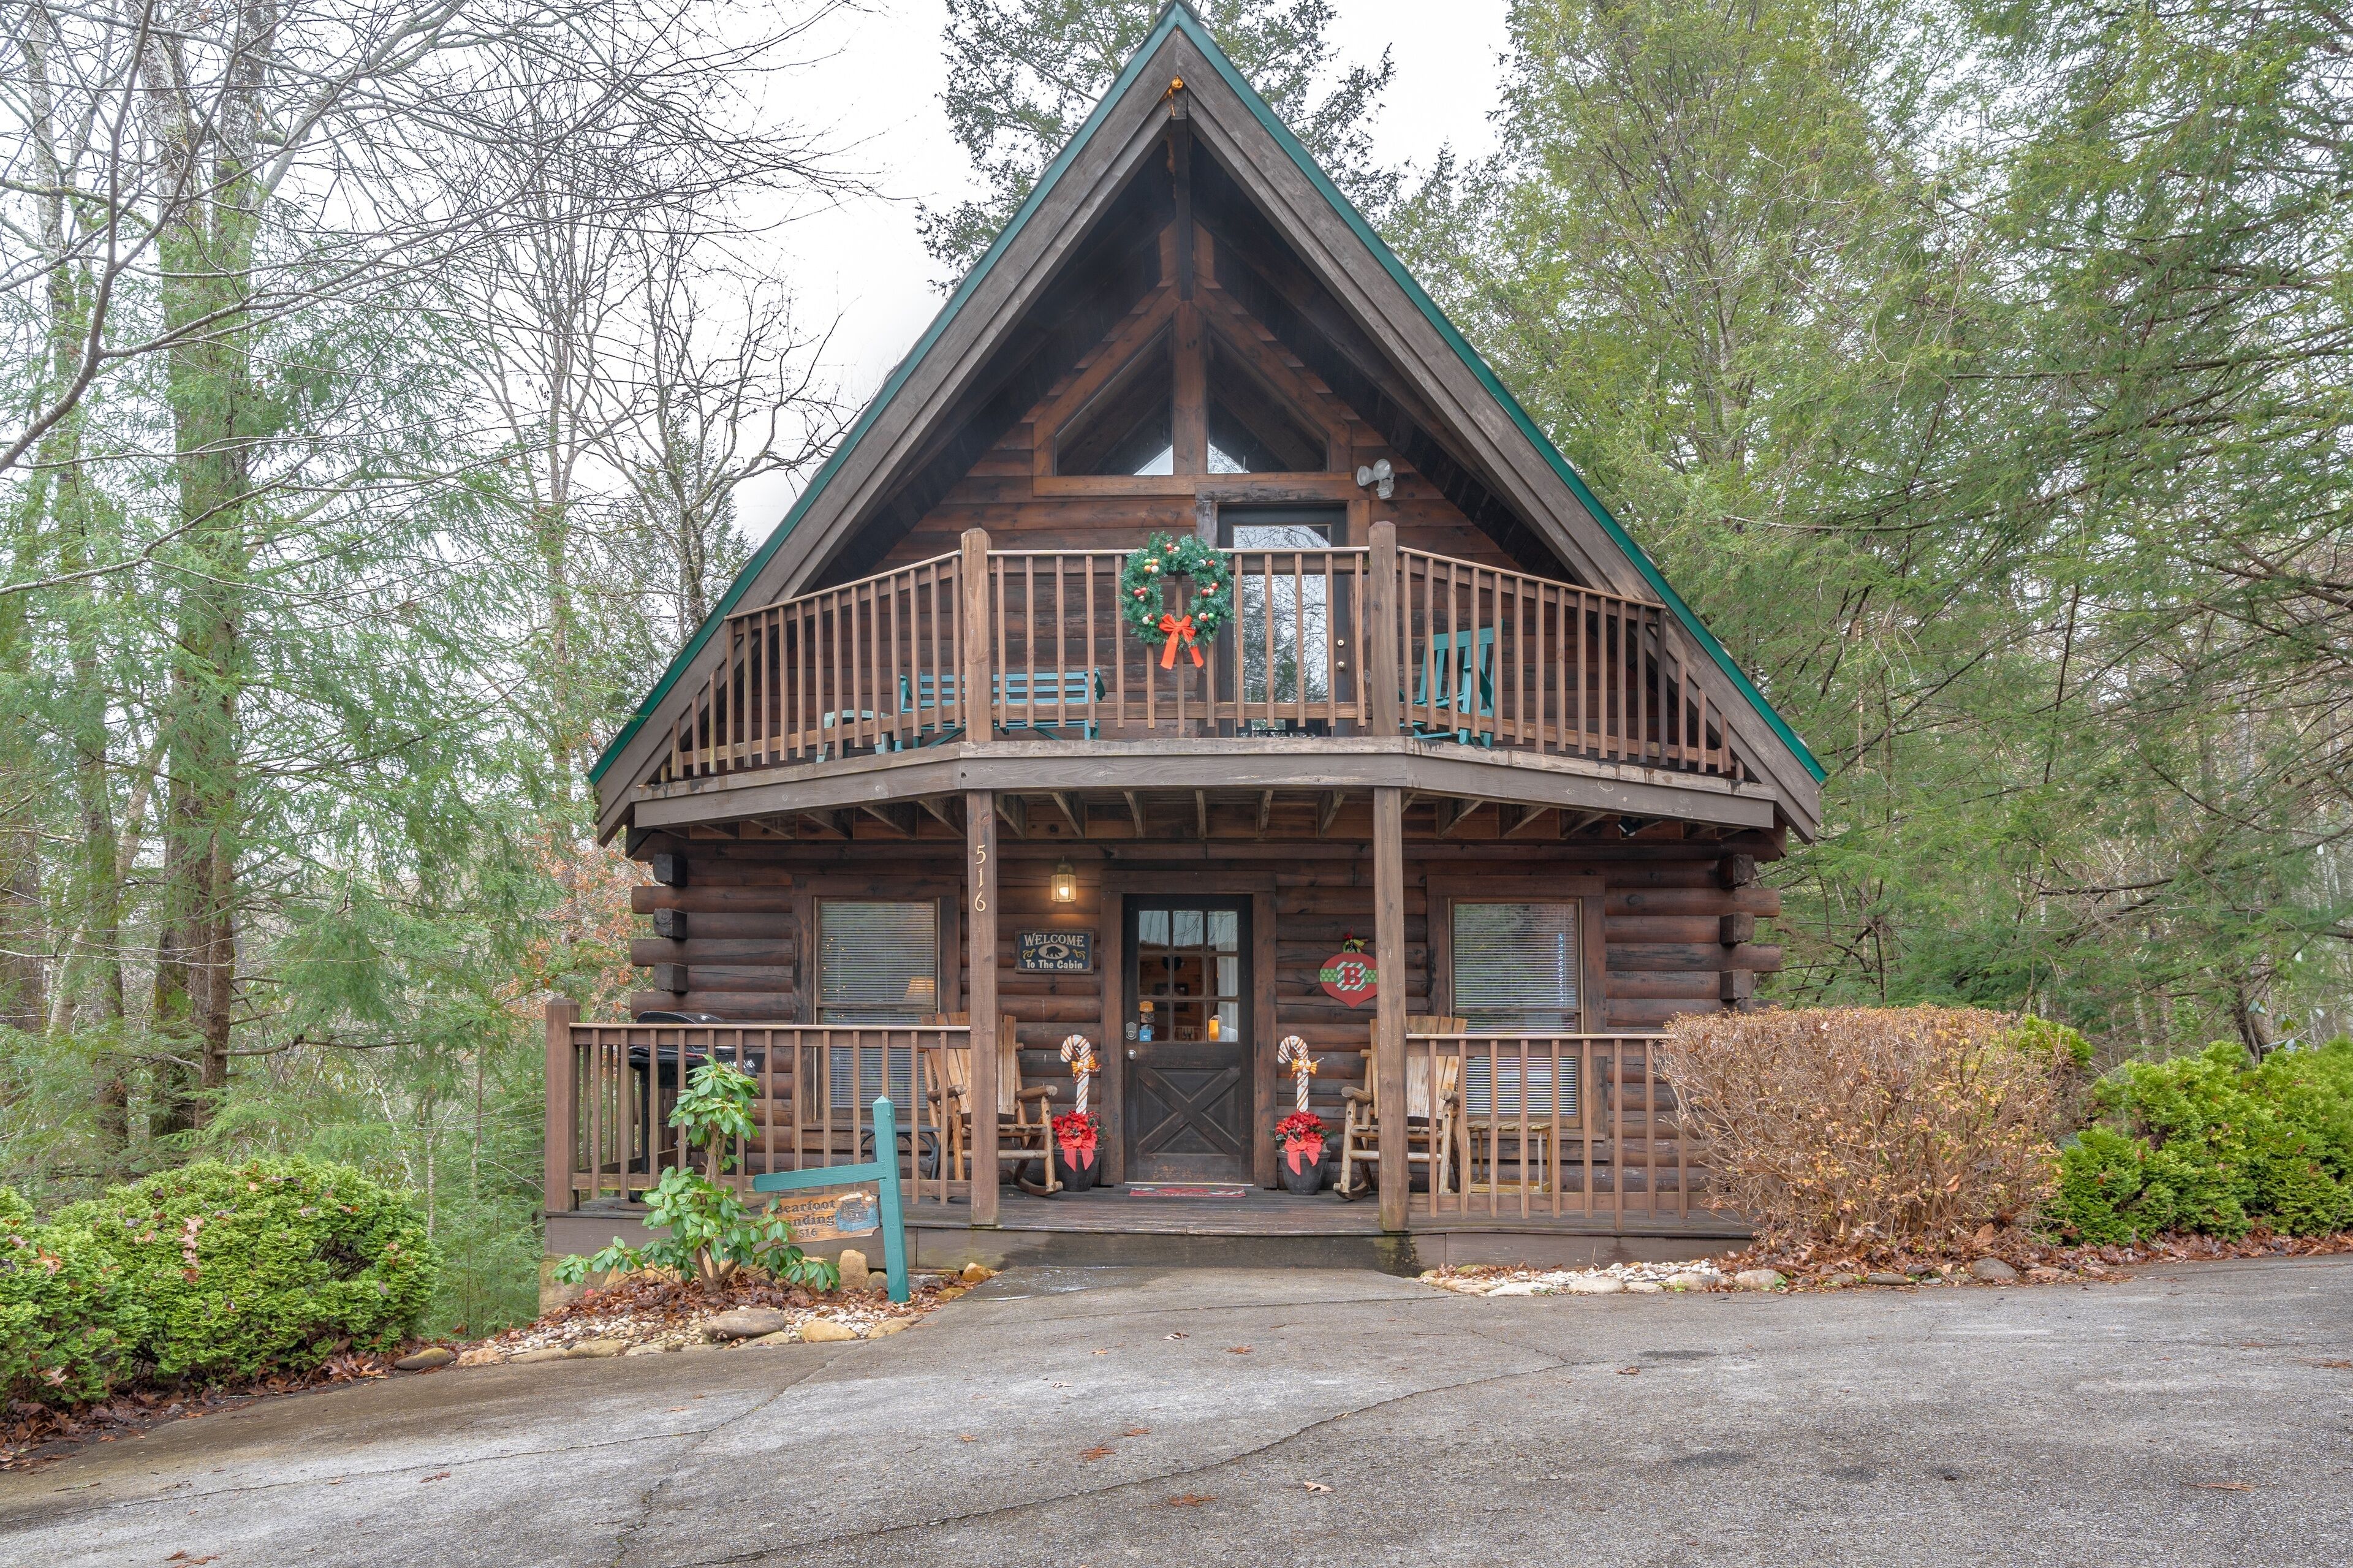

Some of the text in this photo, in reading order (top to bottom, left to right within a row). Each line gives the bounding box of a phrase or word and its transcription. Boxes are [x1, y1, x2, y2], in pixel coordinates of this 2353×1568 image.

[975, 844, 986, 912] 516
[1024, 933, 1085, 947] WELCOME
[1026, 960, 1083, 969] To The Cabin
[1342, 966, 1361, 986] B
[775, 1199, 836, 1214] Bearfoot
[786, 1213, 835, 1226] nding
